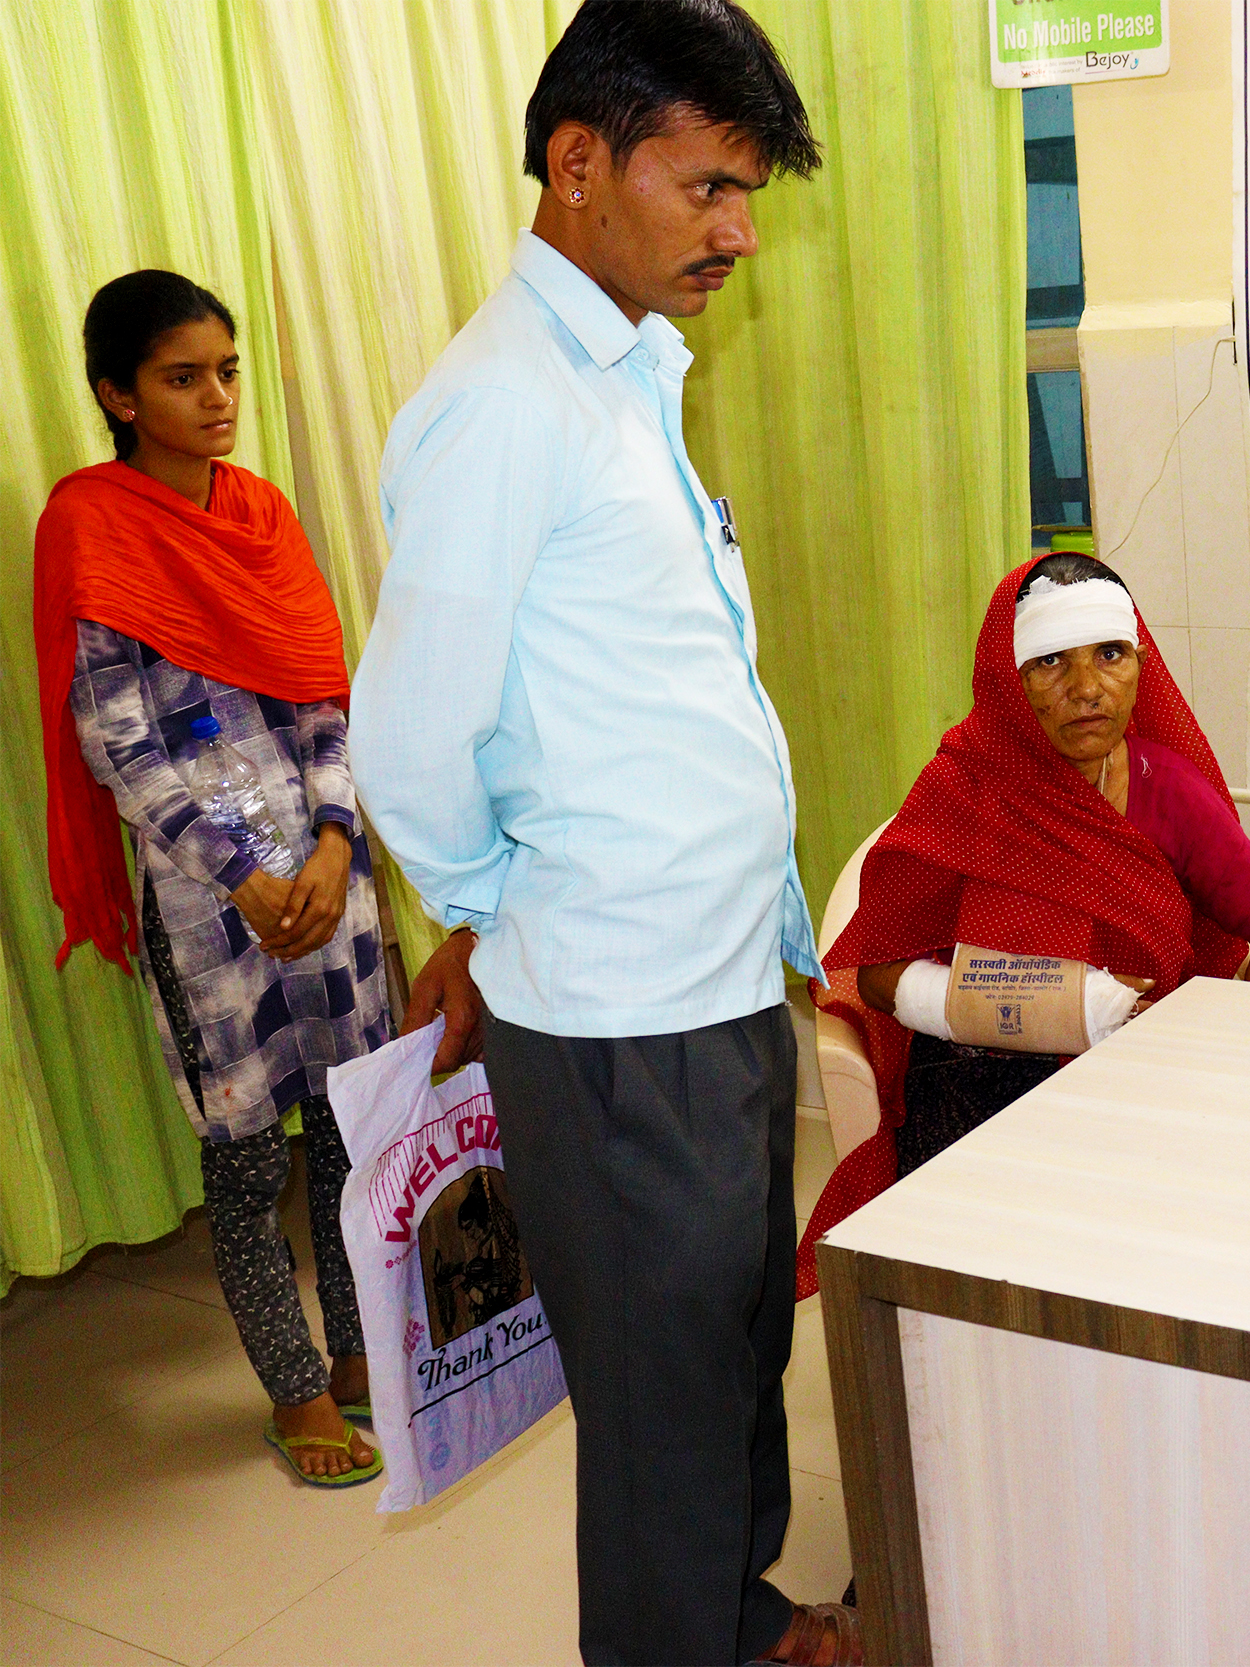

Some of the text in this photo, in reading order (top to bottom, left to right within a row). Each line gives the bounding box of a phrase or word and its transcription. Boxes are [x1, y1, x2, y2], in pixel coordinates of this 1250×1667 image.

[1003, 13, 1154, 50] No Mobile Please
[1086, 51, 1130, 70] Bejoy
[969, 958, 1007, 970] सरस्वती
[962, 970, 979, 982] एवं
[978, 972, 1020, 983] गायनिक
[417, 1331, 494, 1393] Thank
